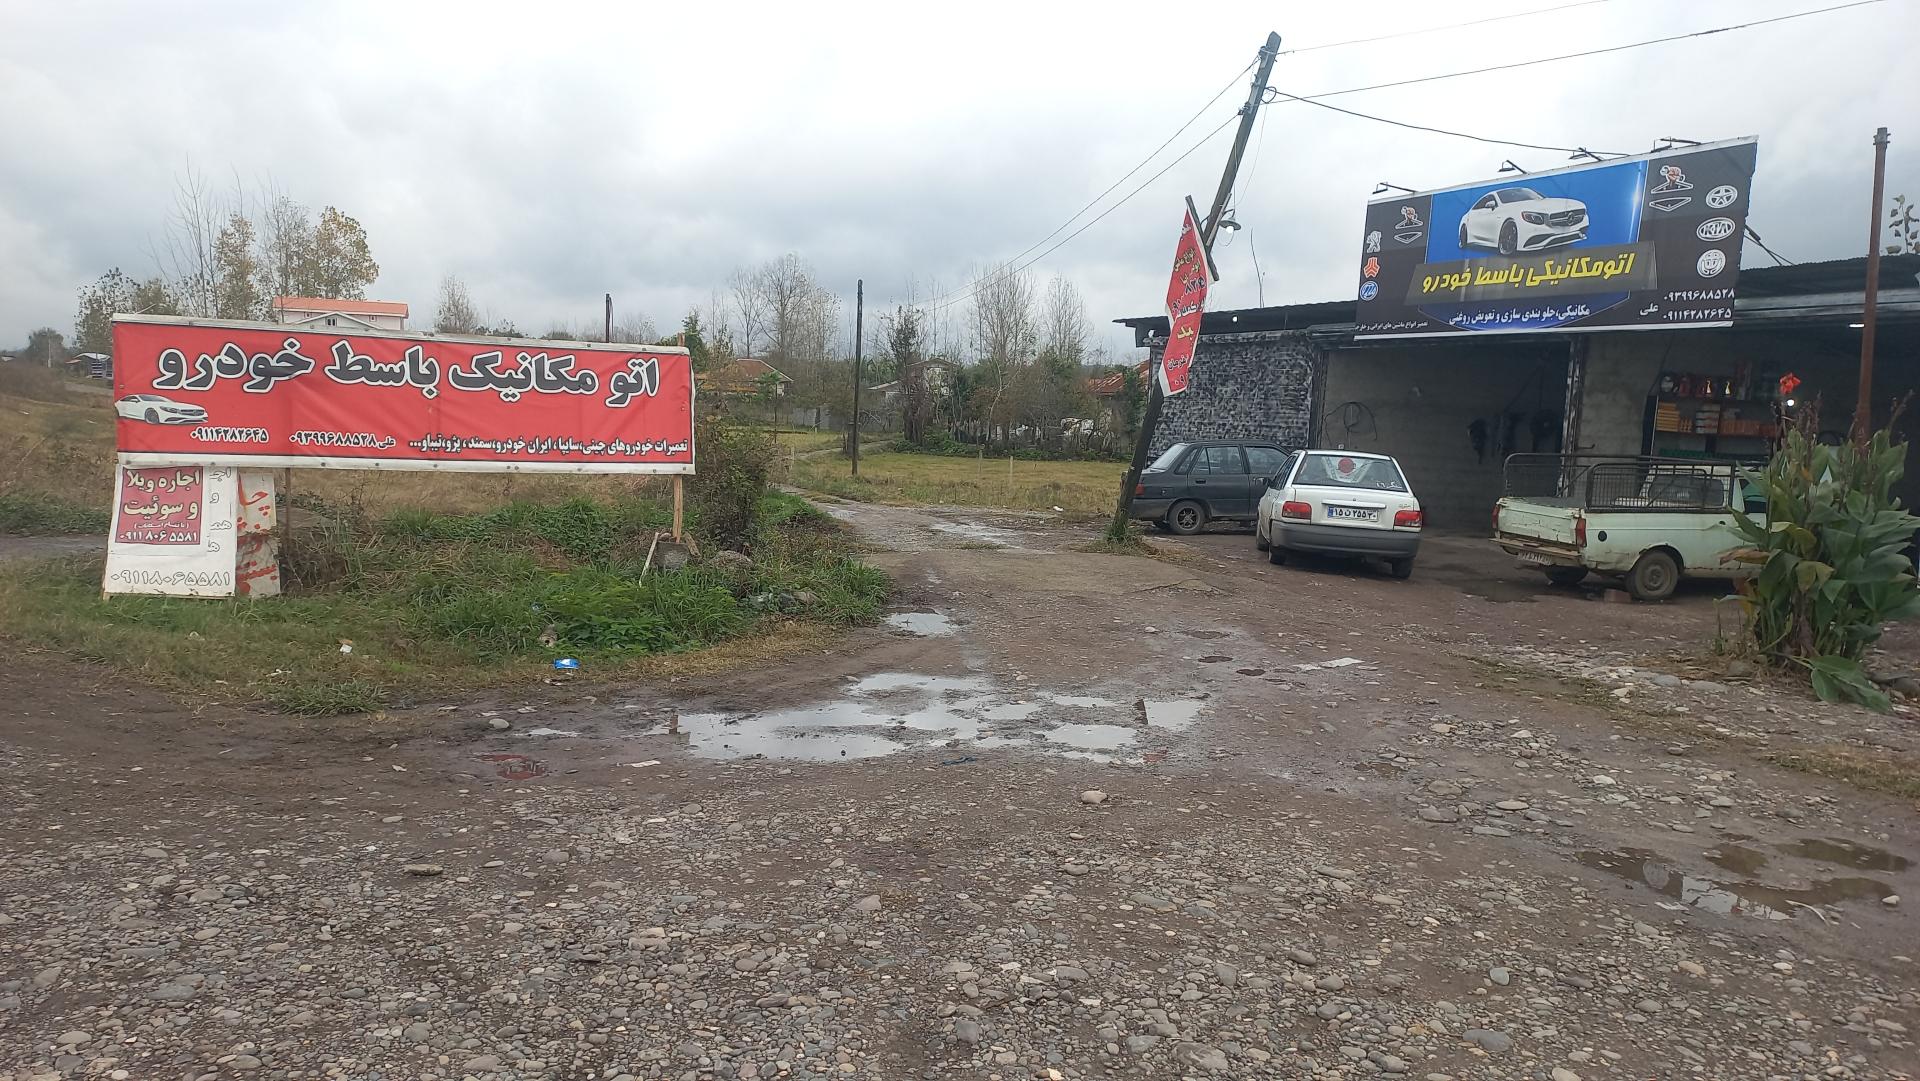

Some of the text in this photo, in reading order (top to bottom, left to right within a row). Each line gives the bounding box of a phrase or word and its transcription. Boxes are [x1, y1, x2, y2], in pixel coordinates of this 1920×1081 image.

[1422, 253, 1636, 294] اتومکانیکی باسط خودرو
[1663, 288, 1735, 302] ۰۹۳۹۹۶۸۸۵۲۸
[1471, 308, 1495, 324] تعویض
[1501, 308, 1521, 323] سازی
[1639, 302, 1659, 316] علی
[1663, 307, 1732, 320] ۰۹۱۱۴۲۸۲۶۴۵
[153, 337, 660, 408] اتو مکانیک باسط خودرو
[190, 426, 269, 443] ۰۹۱۱۴۲۸۲۶۴۵
[527, 437, 552, 454] ایران
[654, 438, 689, 456] تعمیرات
[126, 470, 156, 493] ویلا
[158, 470, 200, 493] اجاره
[123, 495, 199, 520] و سوئیت
[111, 570, 230, 586] ۰۹۱۱۸۰۶۵۵۸۱
